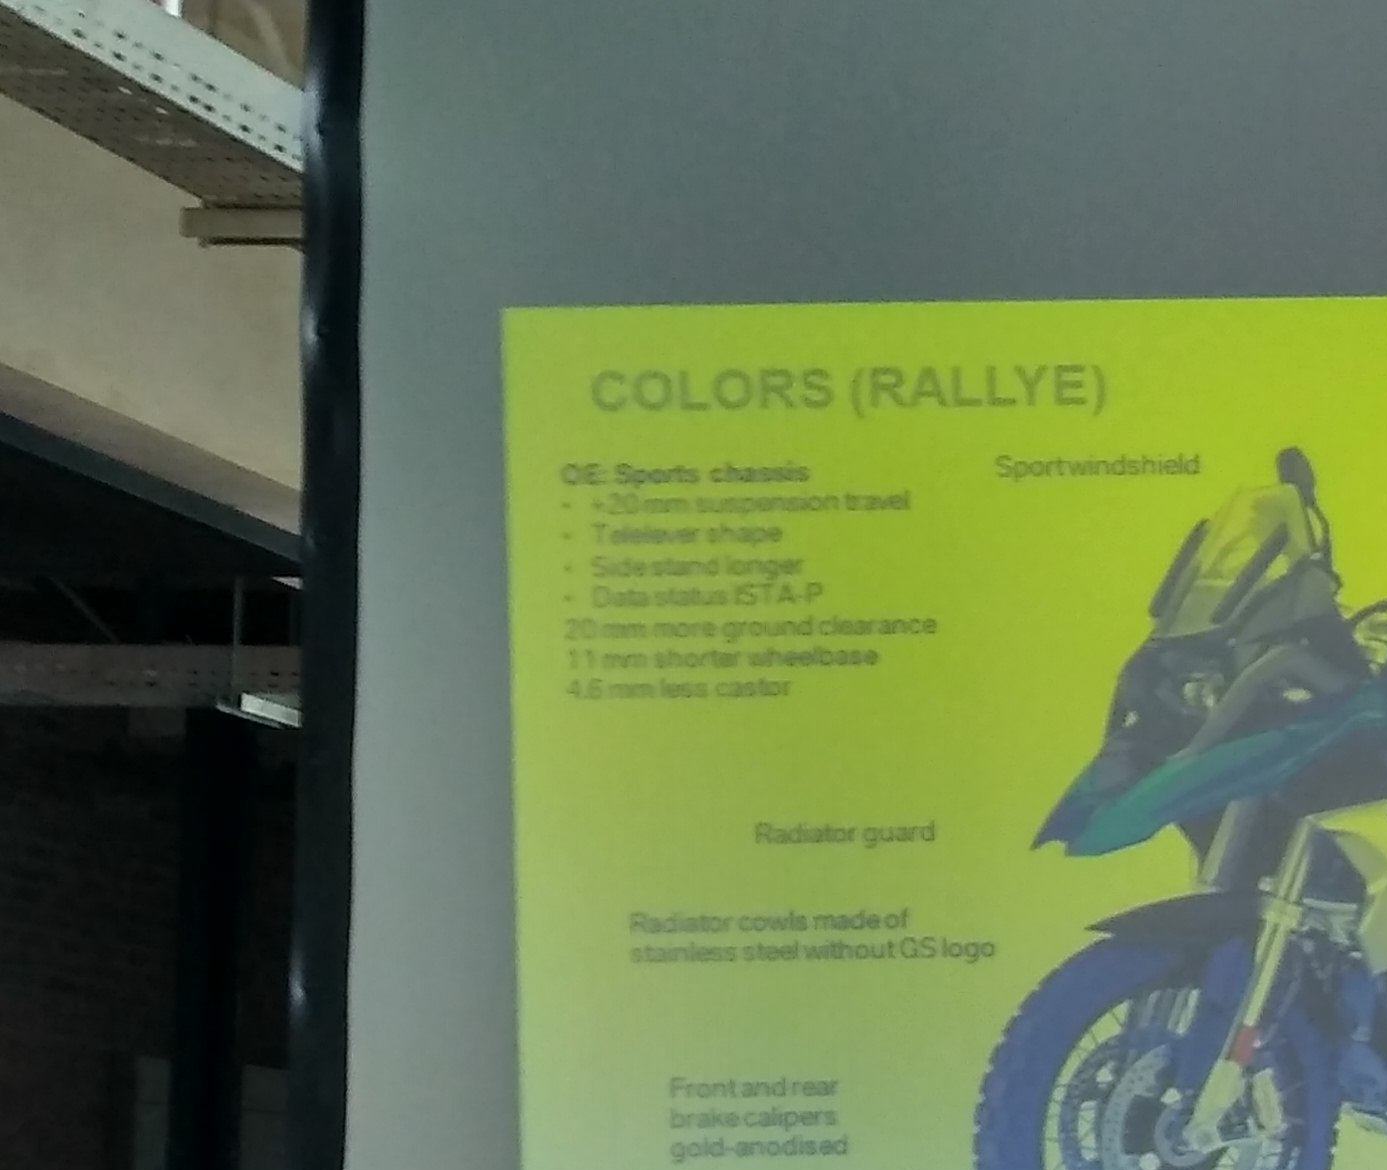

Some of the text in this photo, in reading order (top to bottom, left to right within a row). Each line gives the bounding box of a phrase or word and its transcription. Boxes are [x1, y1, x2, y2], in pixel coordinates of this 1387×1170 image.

[591, 364, 1106, 419] COLORS (RALLYE)
[615, 463, 699, 488] Sports
[709, 461, 811, 483] chassis
[643, 497, 690, 513] mm
[696, 493, 839, 516] suspension
[845, 489, 912, 511] travel
[706, 525, 783, 549] shape
[651, 555, 719, 577] stand
[726, 555, 804, 580] longer
[653, 586, 728, 607] status
[564, 615, 939, 644] 20 mm more ground clearance
[567, 647, 881, 670] 11 mm shorter wheelbase
[607, 681, 655, 698] mm
[659, 678, 709, 698] less
[714, 680, 792, 699] castor
[754, 820, 937, 849] Radiator guard
[628, 907, 911, 934] Radiator cowls made of
[630, 936, 996, 965] stainless steel without GS logo
[668, 1076, 840, 1099] Front and rear
[669, 1106, 838, 1132] brake calipers
[669, 1134, 849, 1164] gold-anodised
